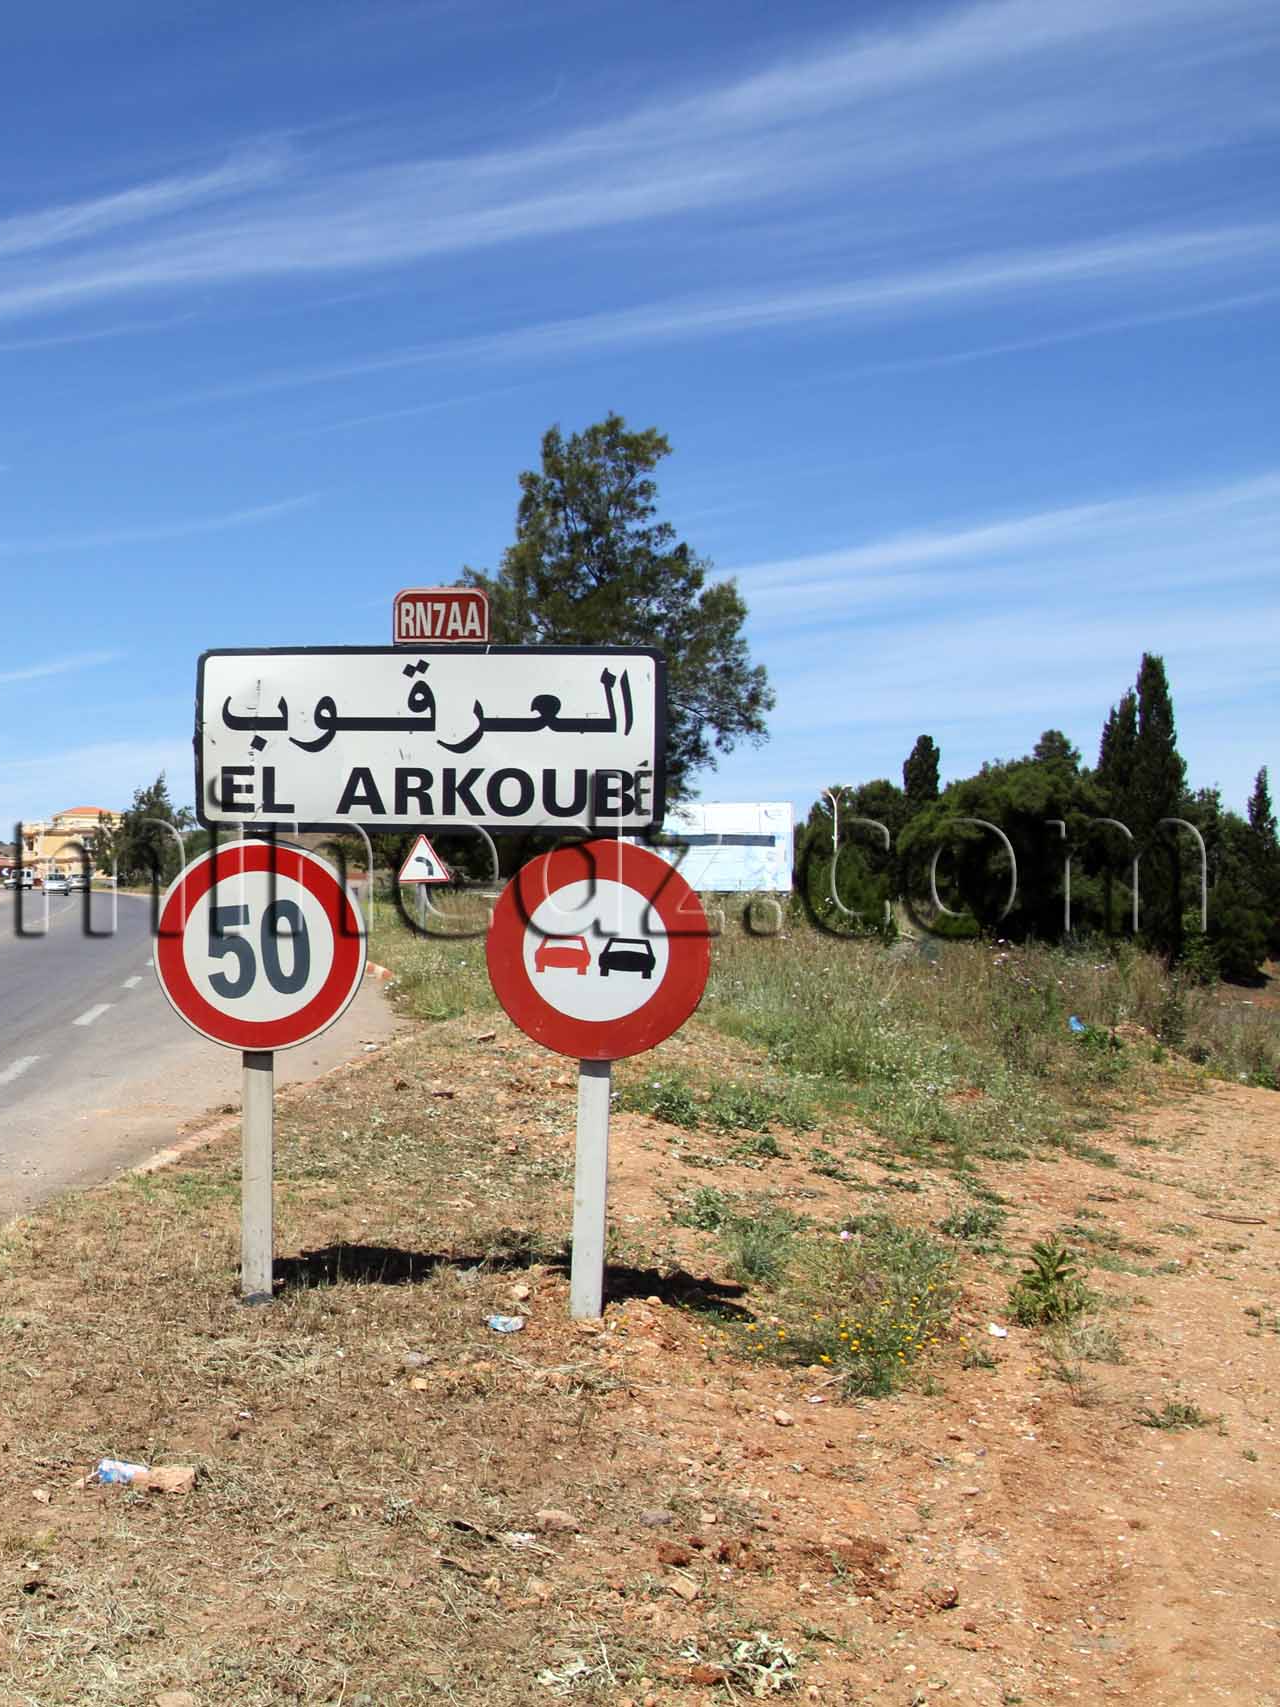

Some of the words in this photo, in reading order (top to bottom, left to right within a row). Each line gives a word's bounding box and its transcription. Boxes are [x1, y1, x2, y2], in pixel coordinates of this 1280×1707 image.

[400, 602, 483, 637] RN7AA
[222, 660, 634, 754] العرقوب
[221, 766, 295, 813] EL
[207, 899, 311, 999] 50
